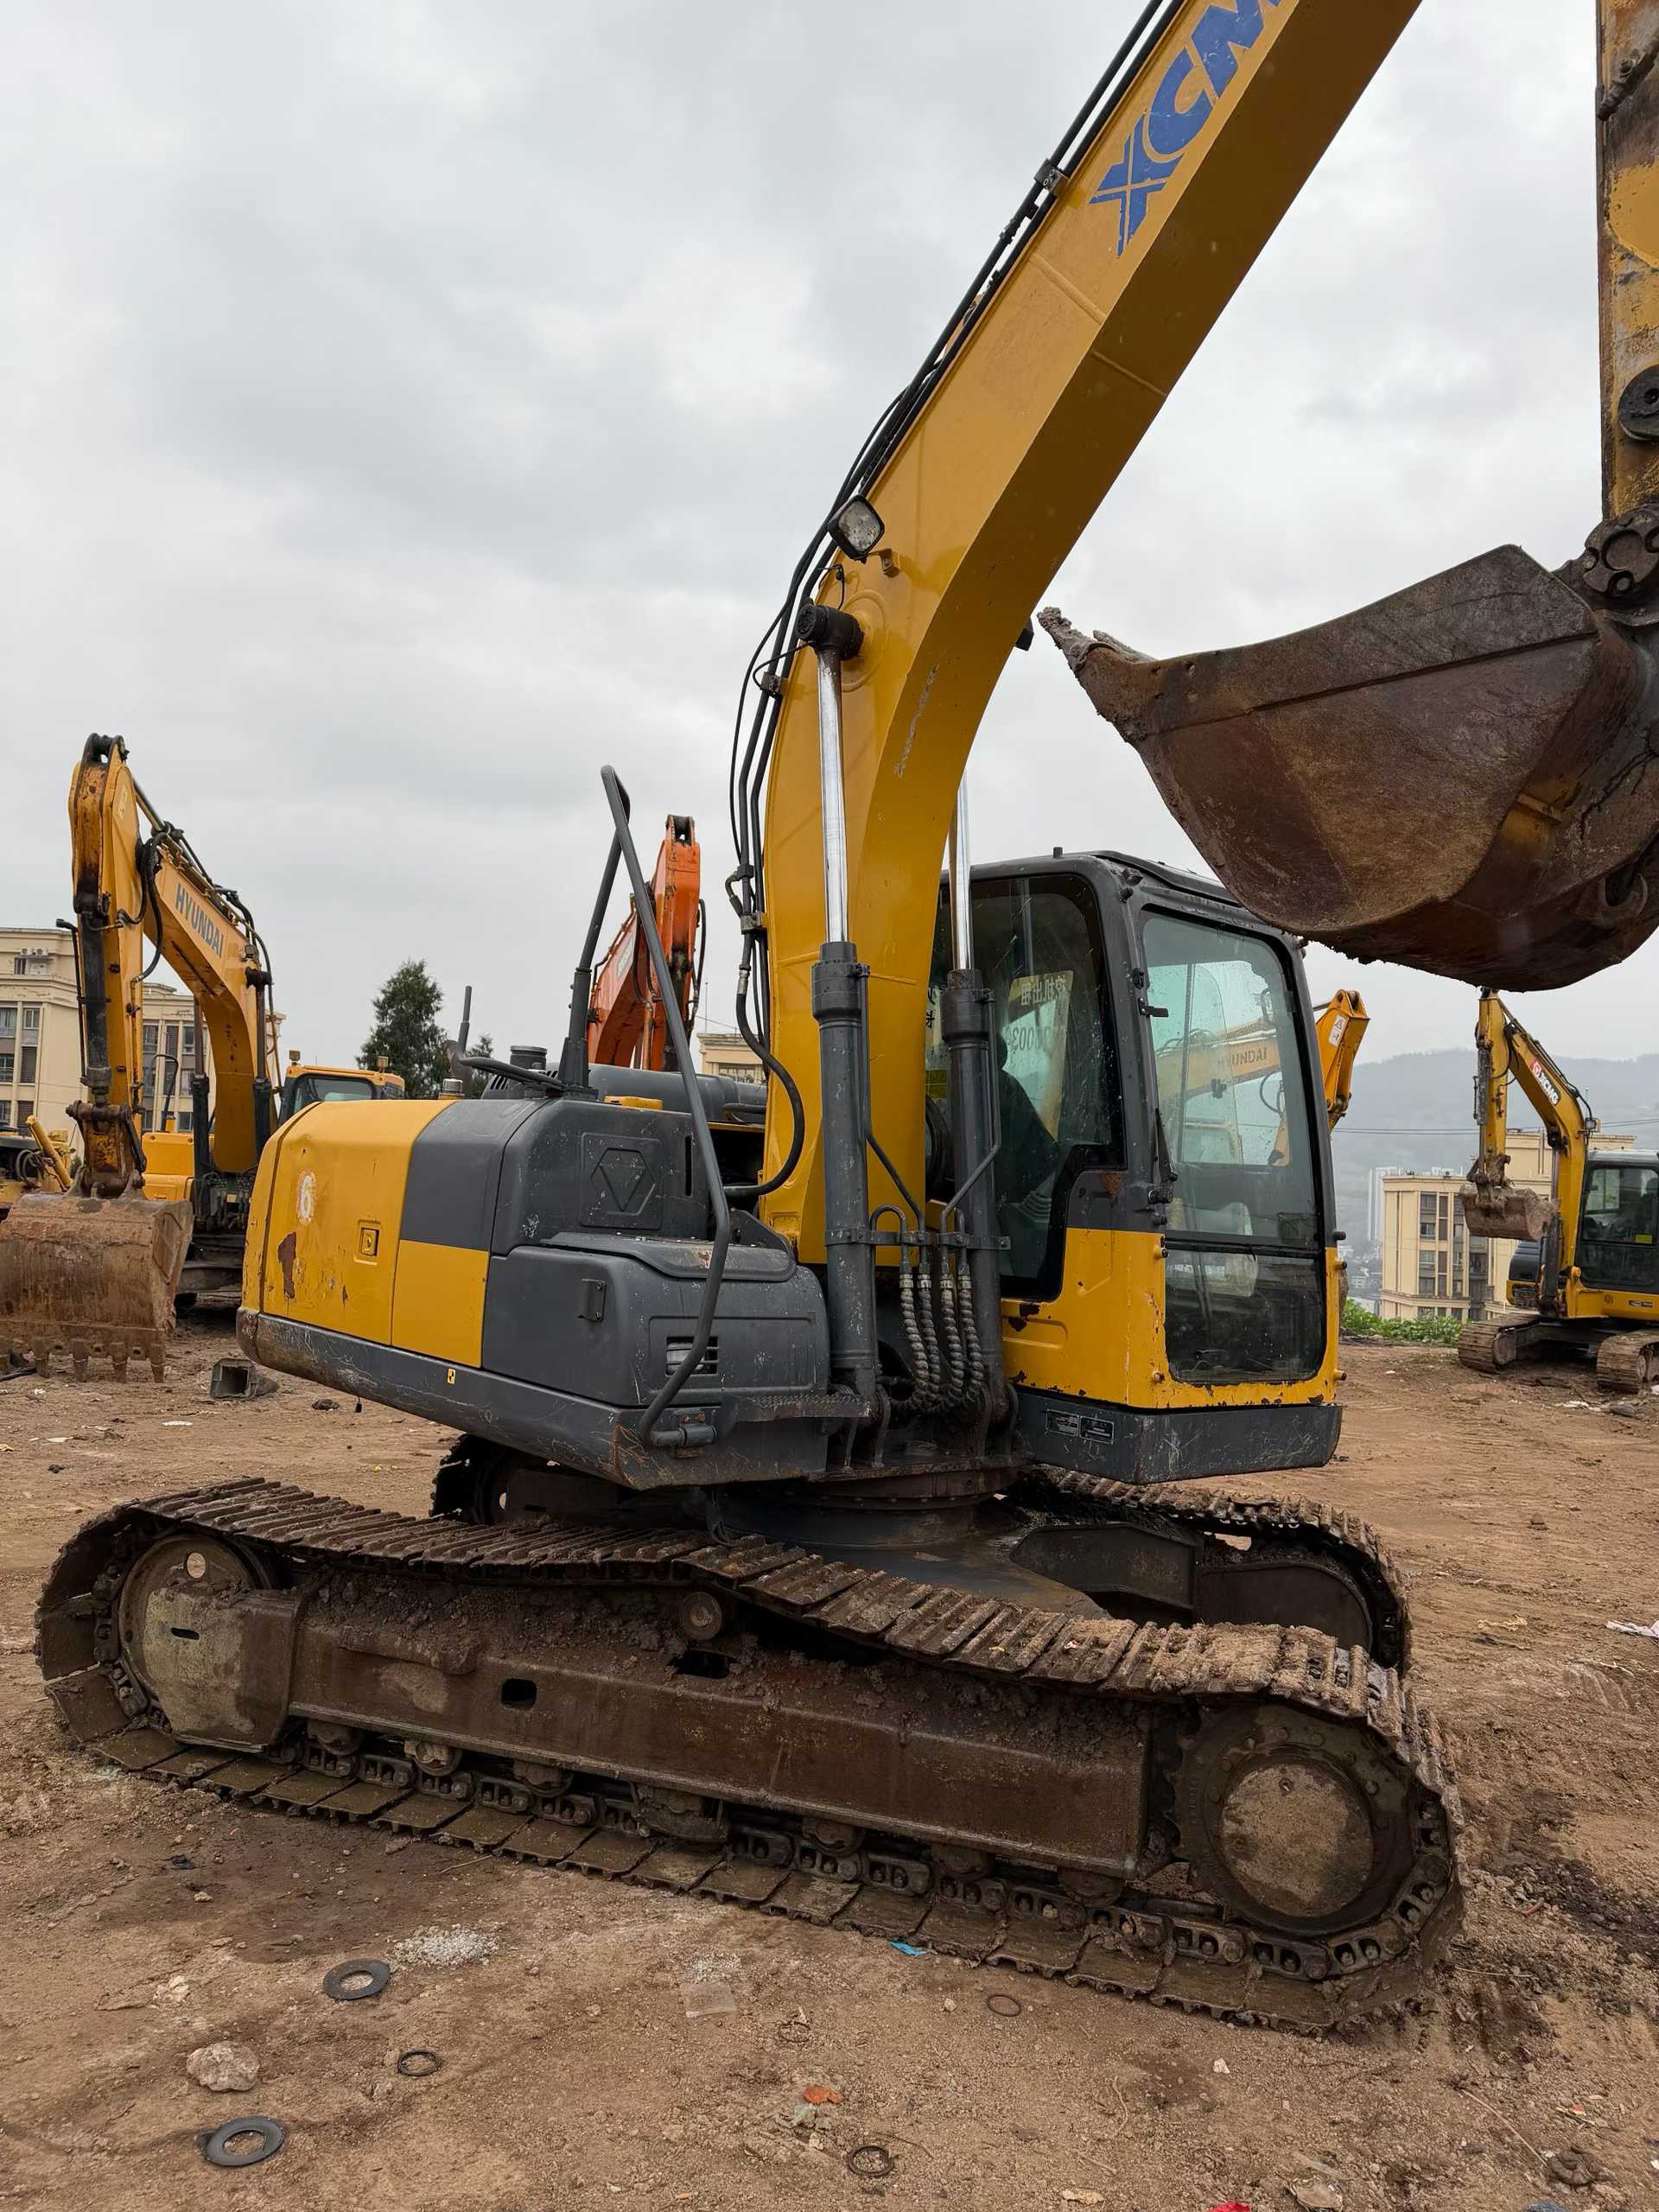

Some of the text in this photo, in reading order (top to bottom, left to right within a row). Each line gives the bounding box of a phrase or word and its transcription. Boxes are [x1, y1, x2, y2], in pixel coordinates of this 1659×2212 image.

[175, 881, 224, 959] HYUNDAI
[1217, 1046, 1268, 1067] HUNDAI
[300, 1174, 313, 1217] 6
